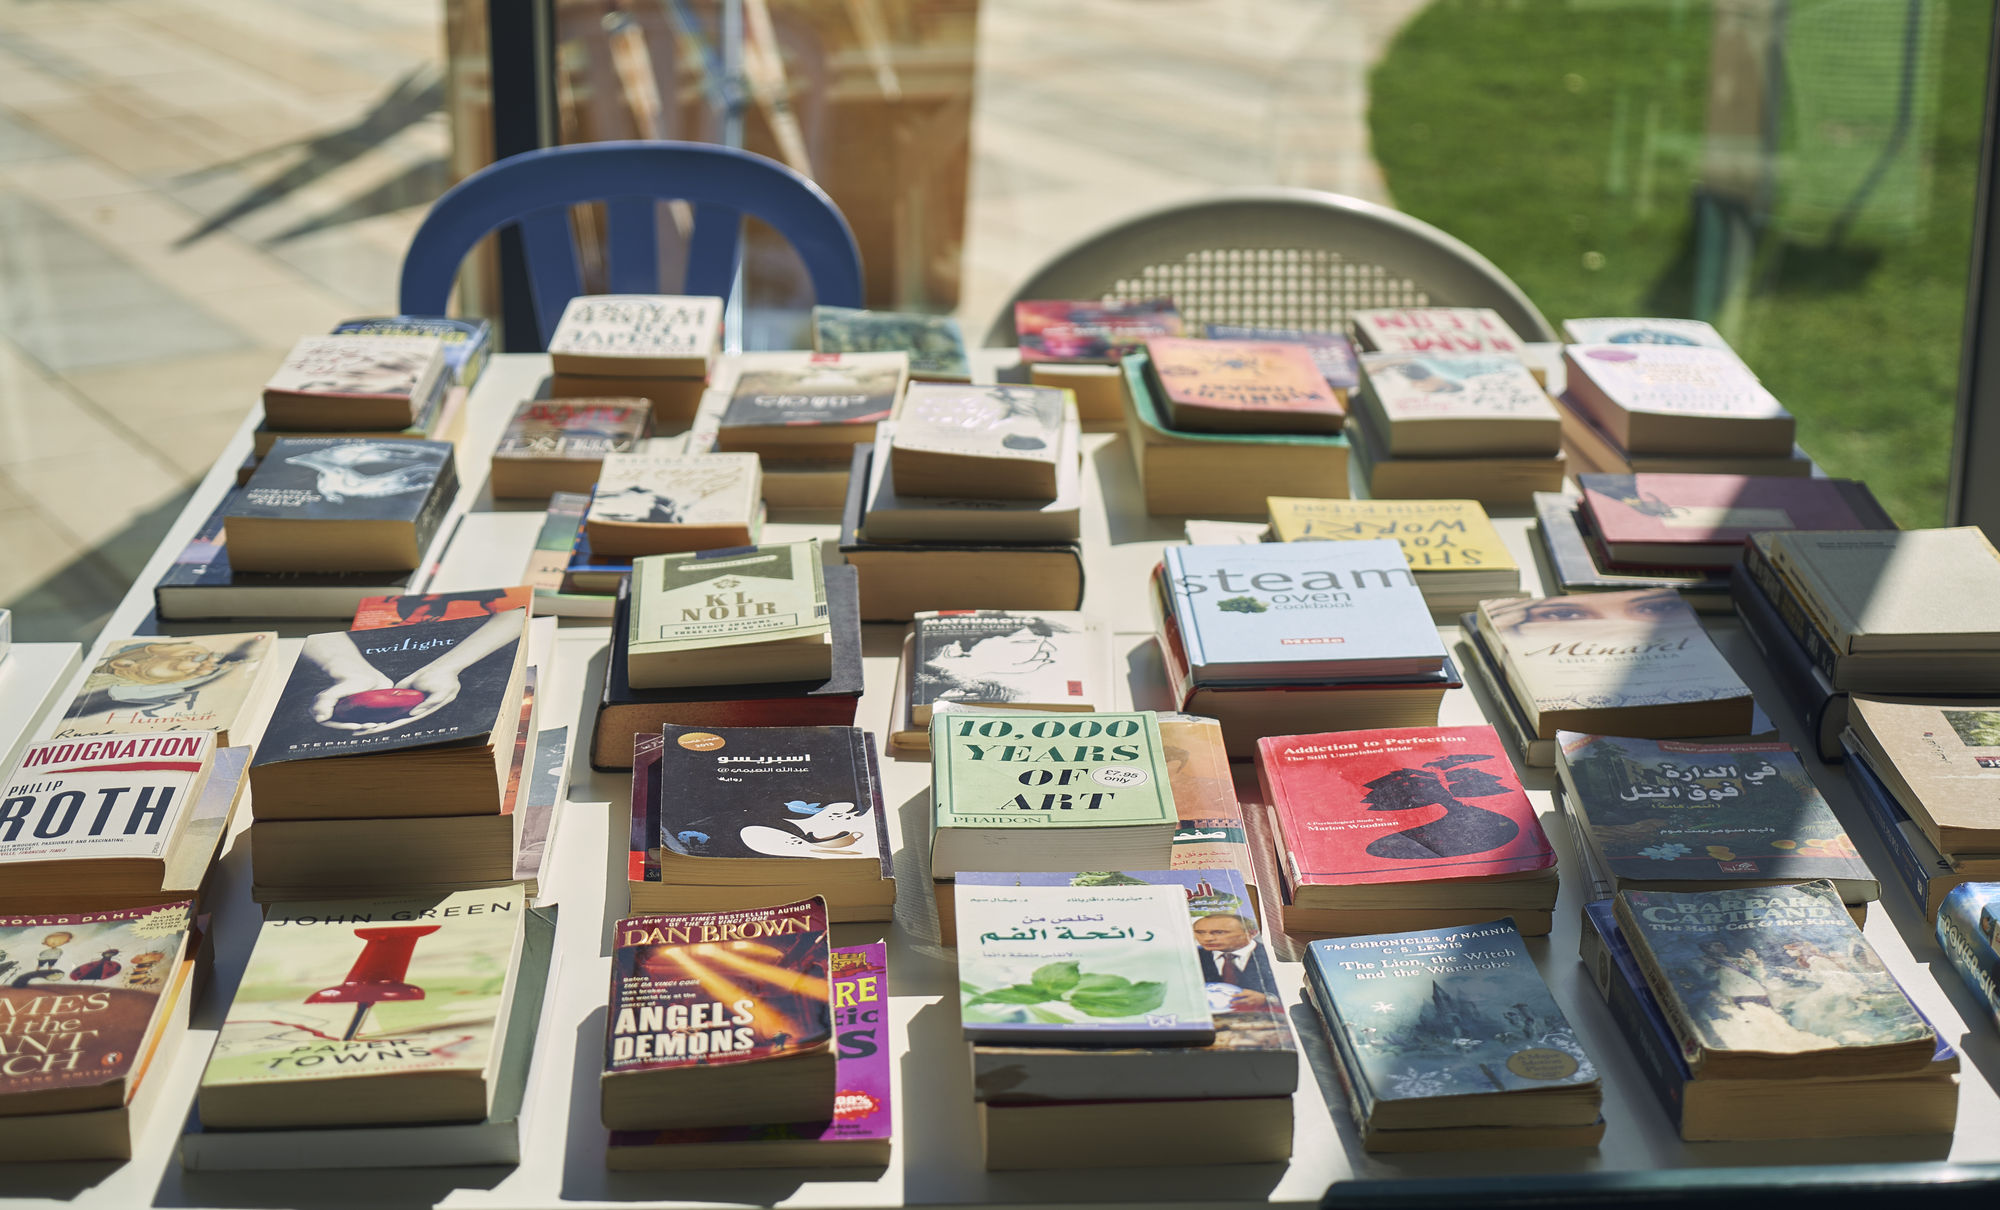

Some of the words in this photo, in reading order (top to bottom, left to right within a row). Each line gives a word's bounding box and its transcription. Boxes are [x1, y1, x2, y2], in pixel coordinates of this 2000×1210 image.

[1175, 568, 1418, 596] steam
[1271, 592, 1351, 604] oven
[681, 602, 777, 622] NOIR
[365, 638, 455, 655] twilight
[106, 711, 217, 725] Humour
[288, 735, 392, 750] STEPHENIE
[400, 726, 460, 740] MEYER
[955, 720, 1140, 741] 10,000
[22, 737, 202, 768] INDIGNATION
[963, 744, 1140, 763] YEARS
[1284, 741, 1358, 755] Addiction
[1385, 735, 1467, 746] Perfection
[1307, 753, 1328, 761] Still
[1330, 747, 1384, 759] Unravished
[717, 754, 810, 764] اسبريسو
[1018, 768, 1089, 786] OF
[1104, 769, 1139, 779] £7.95
[1104, 775, 1131, 785] only
[1661, 763, 1737, 781] الدارة
[1744, 761, 1776, 785] في
[8, 781, 63, 797] PHILIP
[1619, 784, 1680, 801] التل
[1687, 782, 1739, 801] فوق
[996, 792, 1115, 811] ART
[0, 786, 176, 842] ROTH
[953, 816, 1041, 824] PHAIDON
[1348, 821, 1399, 830] Woodman
[718, 910, 775, 921] BESTSELLING
[777, 903, 811, 914] AUTHOR
[1677, 895, 1836, 913] BARBARA
[0, 917, 69, 926] ROALD
[82, 911, 139, 923] DAHL
[274, 914, 372, 928] JOHN
[391, 901, 512, 922] GREEN
[1022, 915, 1046, 924] من
[1050, 913, 1104, 924] تخلص
[1642, 906, 1832, 924] CARTLAND
[622, 925, 692, 947] DAN
[699, 915, 812, 944] BROWN
[1054, 926, 1155, 942] رائحة
[1650, 923, 1681, 932] The
[1778, 919, 1802, 927] the
[1805, 918, 1848, 927] King
[980, 926, 1047, 945] الفم
[1323, 944, 1346, 952] The
[1350, 936, 1441, 949] CHRONICLES
[1445, 934, 1459, 943] of
[1460, 926, 1515, 939] NARNIA
[1382, 947, 1396, 955] C.
[1400, 945, 1412, 953] S.
[1417, 942, 1463, 952] LEWIS
[1339, 960, 1375, 971] The
[1381, 957, 1425, 969] Lion,
[1430, 954, 1457, 964] the
[1463, 949, 1516, 961] Witch
[1356, 970, 1386, 980] and
[1393, 967, 1420, 977] the
[1425, 959, 1511, 975] Wardrobe
[832, 976, 878, 1008] RE
[0, 992, 110, 1016] MES
[24, 1016, 81, 1034] the
[614, 999, 754, 1035] ANGELS
[291, 1039, 415, 1054] PAPER
[613, 1027, 755, 1061] DEMONS
[269, 1046, 433, 1069] TOWNS
